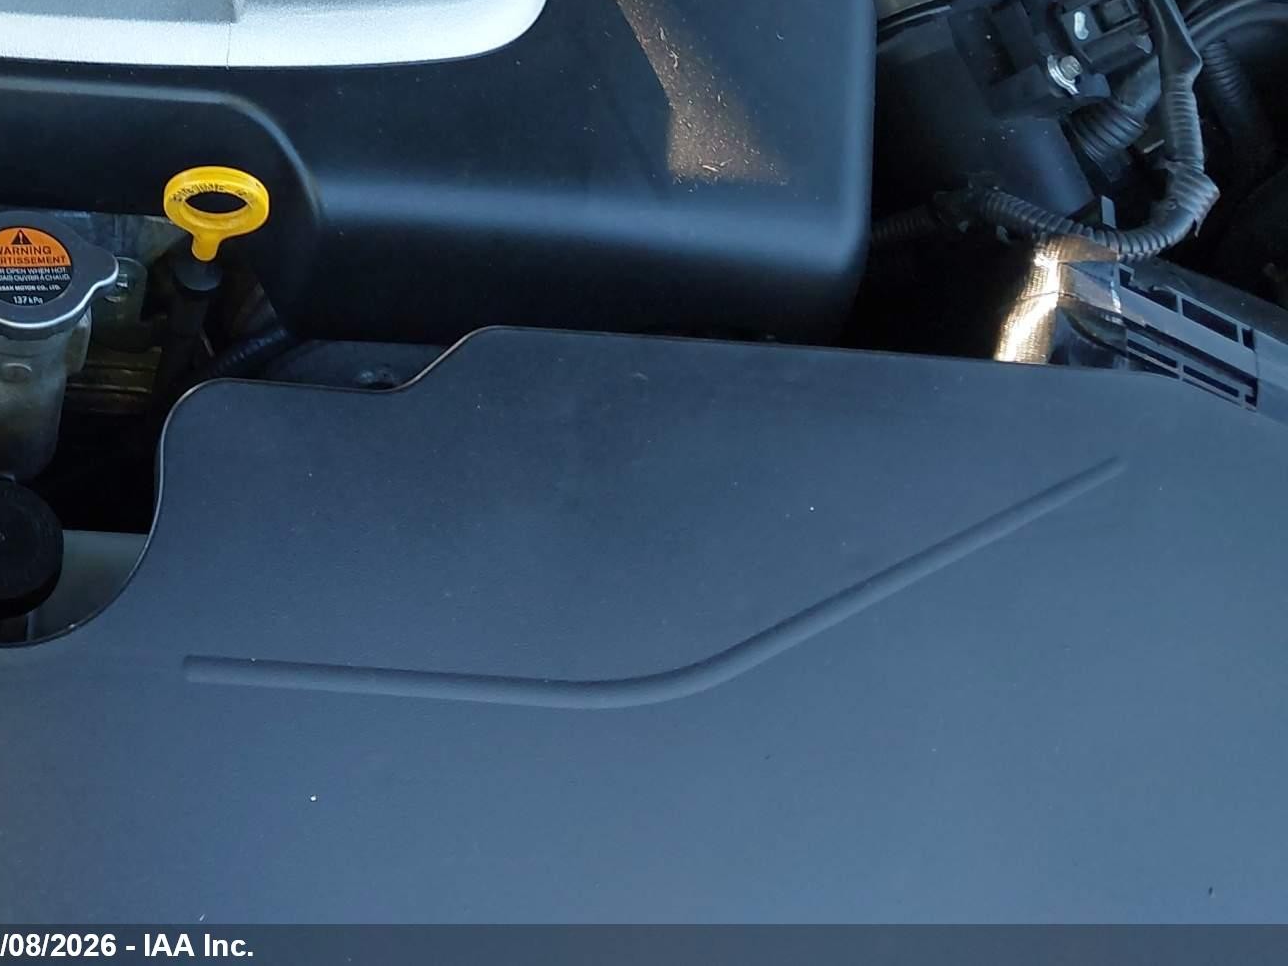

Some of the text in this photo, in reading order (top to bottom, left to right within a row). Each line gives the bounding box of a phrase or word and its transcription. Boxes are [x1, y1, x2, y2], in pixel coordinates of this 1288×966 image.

[7, 267, 27, 275] OPEN
[14, 274, 39, 282] OUVRIR
[13, 296, 27, 304] 137
